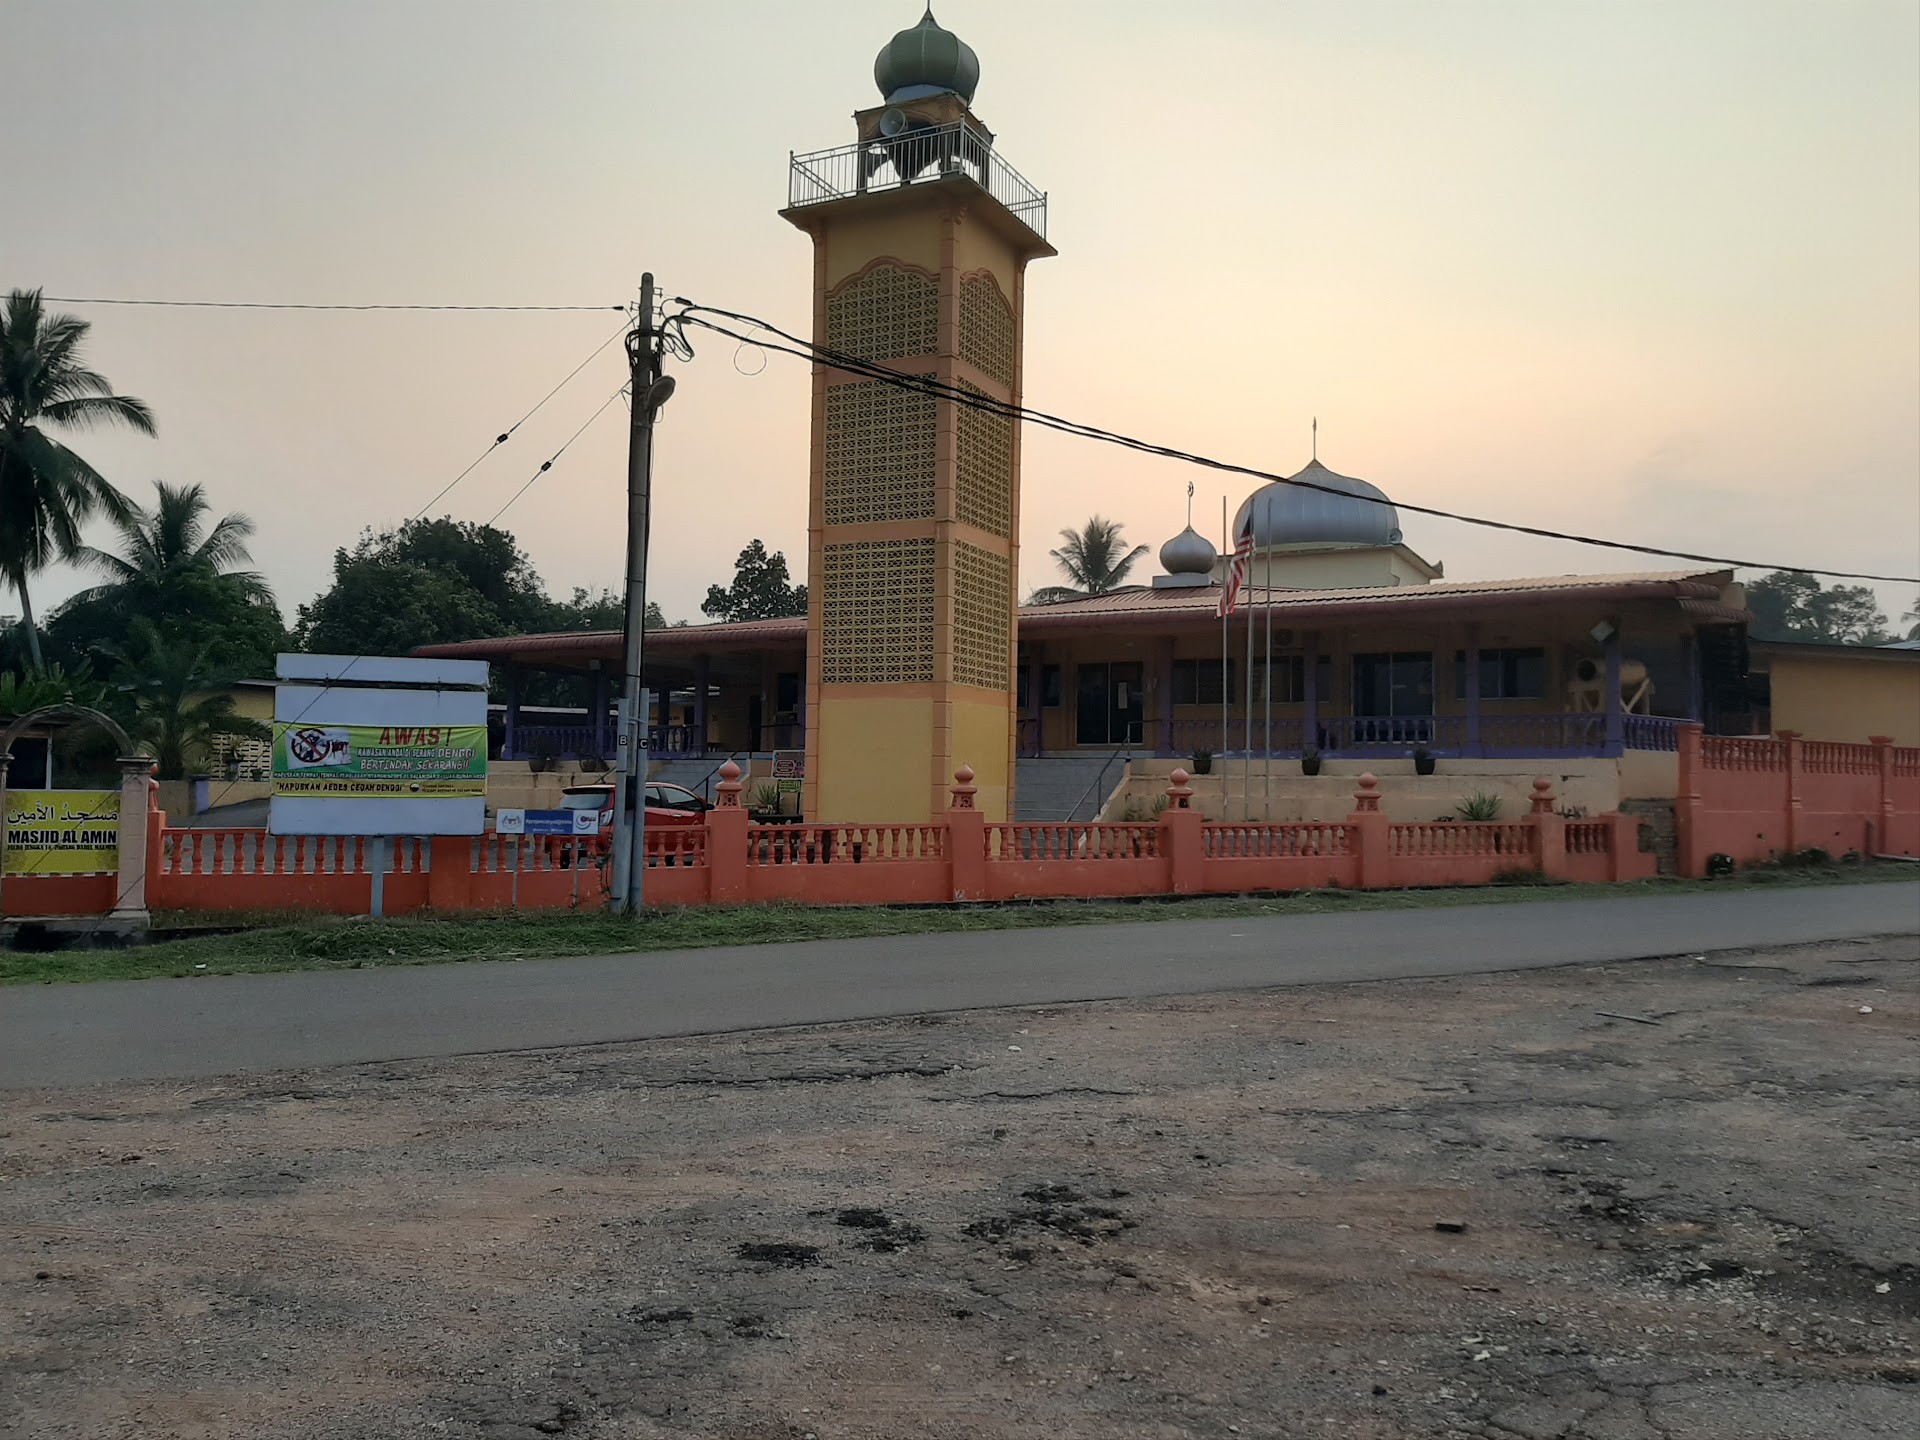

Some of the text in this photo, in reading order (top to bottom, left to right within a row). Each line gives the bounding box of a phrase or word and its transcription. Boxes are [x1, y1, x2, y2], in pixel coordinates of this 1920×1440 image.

[620, 736, 627, 744] B
[640, 739, 648, 748] C
[437, 748, 476, 758] DENGGI
[360, 759, 412, 771] BERTINDAK
[323, 783, 347, 791] AEDES
[8, 830, 117, 844] MASJID AL AMIN
